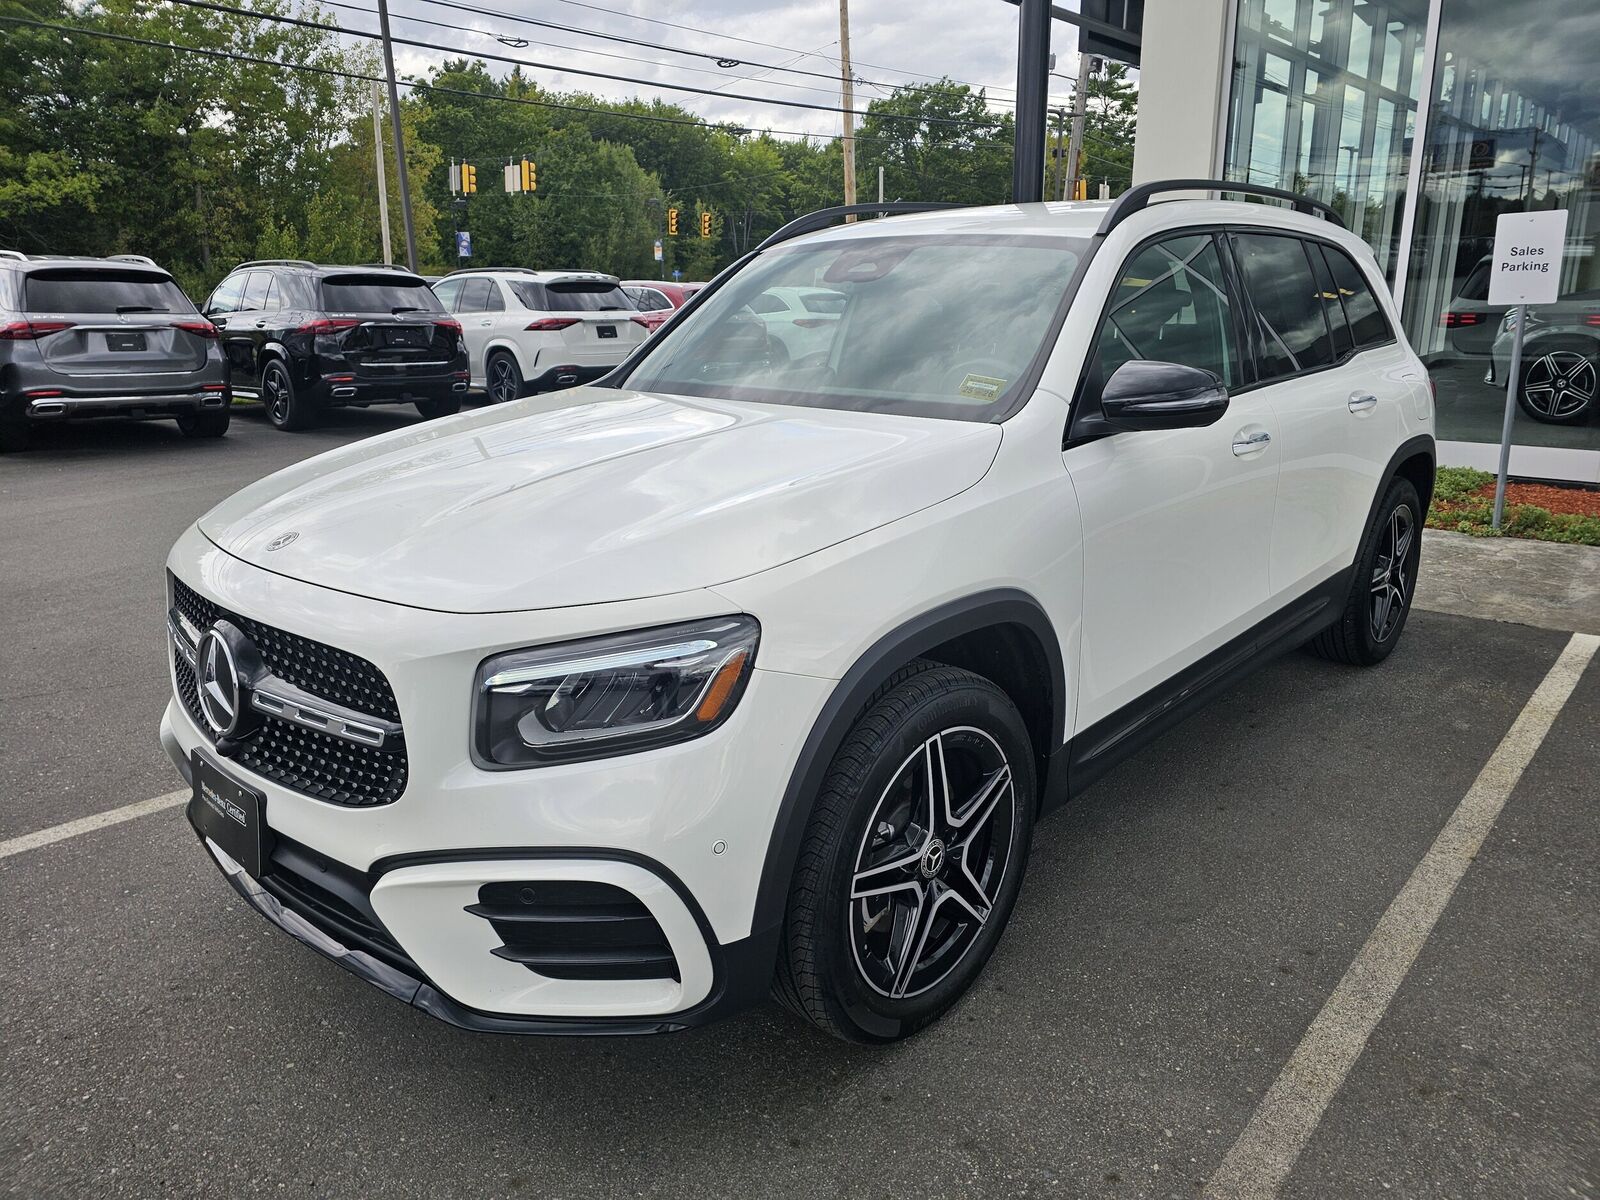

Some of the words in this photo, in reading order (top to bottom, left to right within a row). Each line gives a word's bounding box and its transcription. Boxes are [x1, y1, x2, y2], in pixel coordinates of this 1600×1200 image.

[1510, 246, 1544, 256] Sales
[1501, 261, 1550, 273] Parking
[226, 802, 246, 823] Certified
